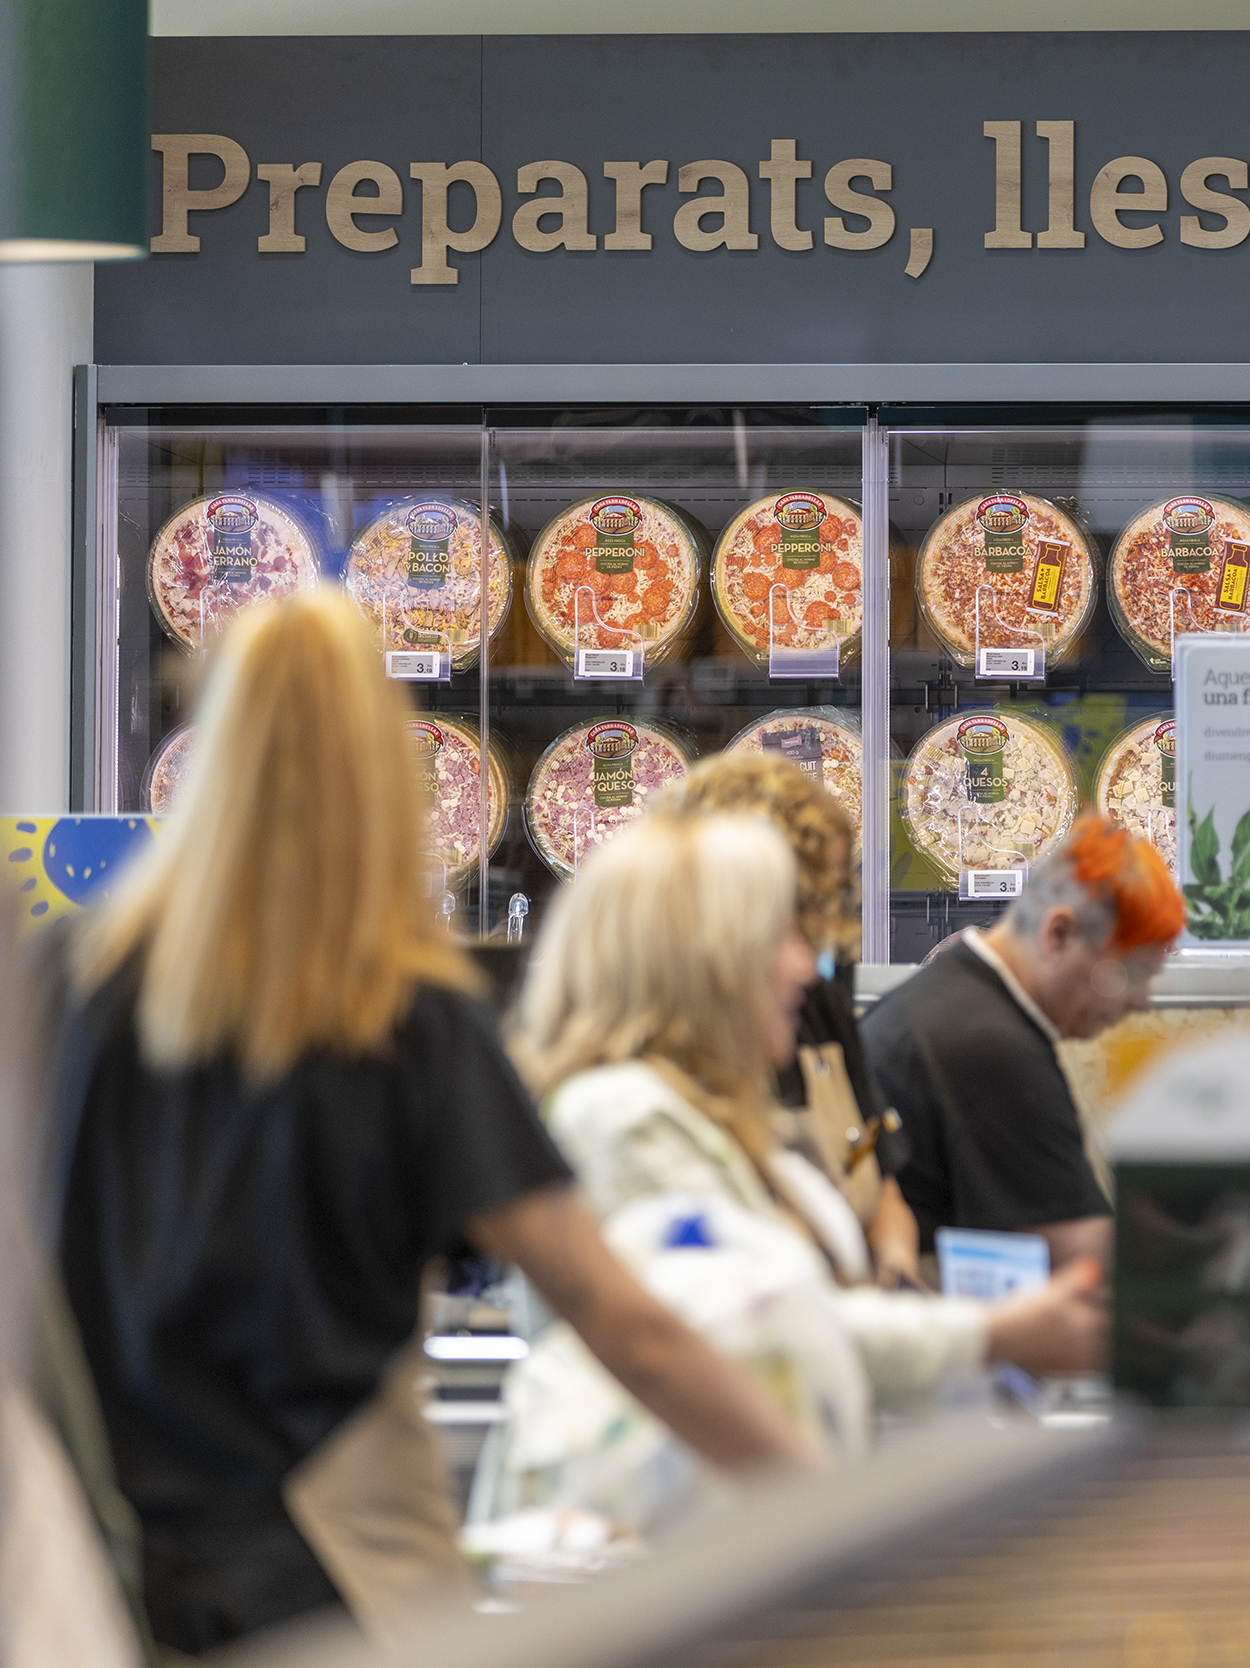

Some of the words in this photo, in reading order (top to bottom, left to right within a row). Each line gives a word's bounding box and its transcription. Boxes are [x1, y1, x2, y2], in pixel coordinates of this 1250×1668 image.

[149, 133, 935, 285] Preparats,
[213, 543, 252, 556] JAMÓN
[585, 547, 645, 557] PEPPERONI
[770, 543, 831, 553] PEPPERONI
[974, 546, 1033, 557] BARBACOA
[1160, 547, 1219, 558] BARBACOA
[207, 556, 258, 567] SERRANO
[408, 551, 449, 562] POLLO
[412, 562, 450, 573] BACON
[1203, 692, 1239, 706] una
[594, 767, 633, 782] JAMÓN
[981, 767, 989, 776] 4
[597, 780, 636, 792] QUESO
[964, 777, 1008, 788] QUESOS
